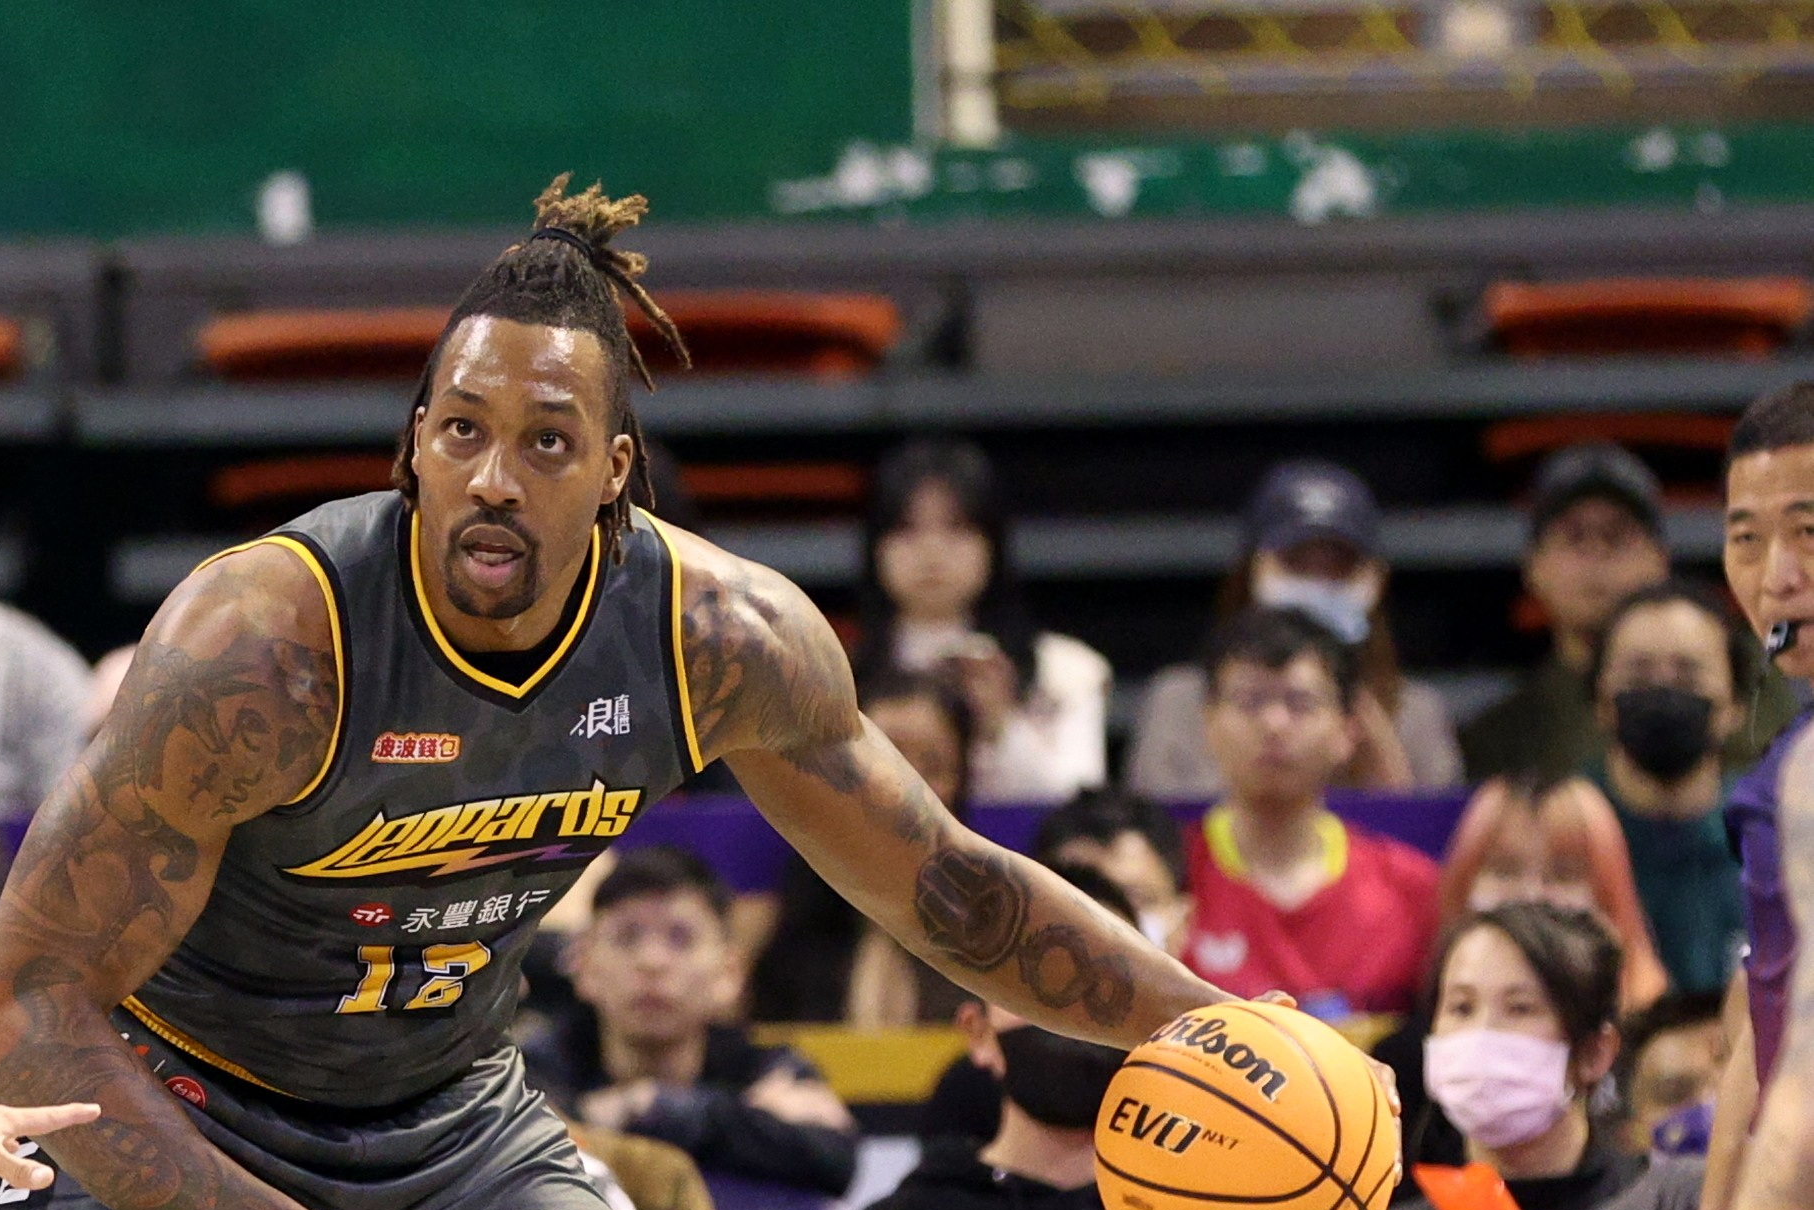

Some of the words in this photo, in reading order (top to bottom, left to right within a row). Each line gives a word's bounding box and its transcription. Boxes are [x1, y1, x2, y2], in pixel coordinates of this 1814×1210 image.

[373, 735, 459, 761] 波波錢包
[400, 889, 551, 933] 永豐銀行
[335, 940, 491, 1014] 12
[1202, 1130, 1239, 1150] NXT
